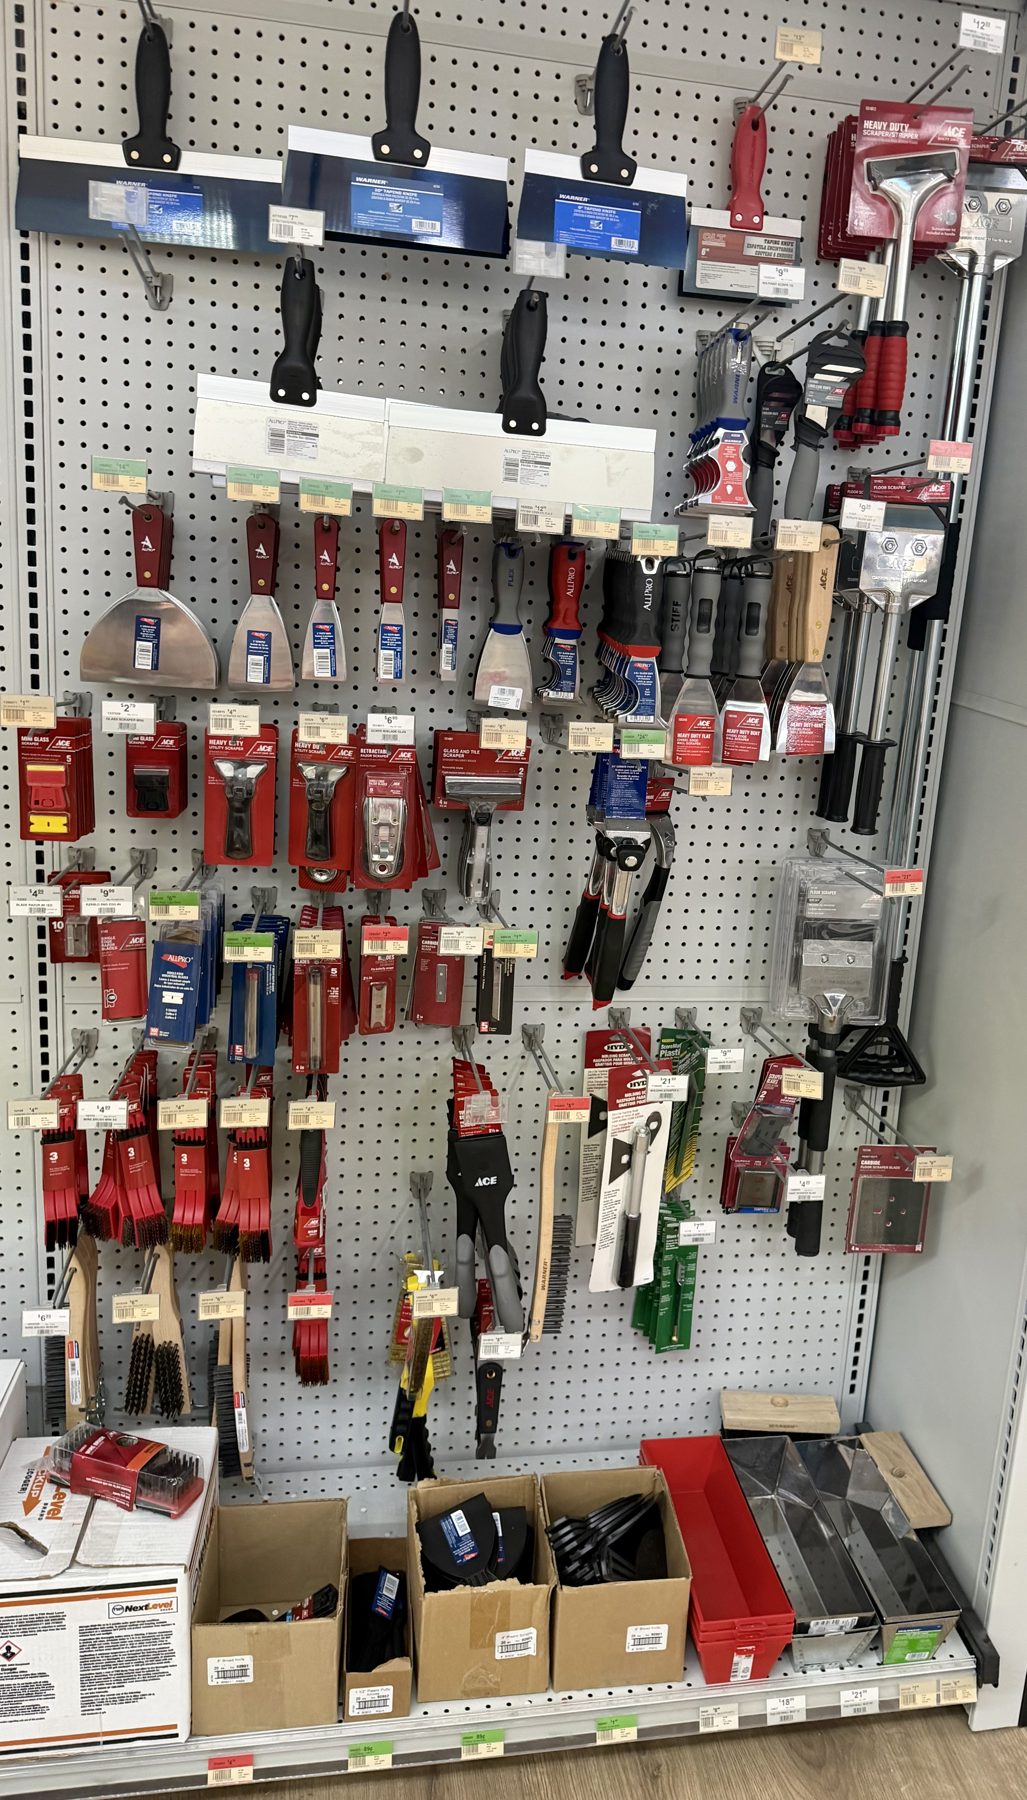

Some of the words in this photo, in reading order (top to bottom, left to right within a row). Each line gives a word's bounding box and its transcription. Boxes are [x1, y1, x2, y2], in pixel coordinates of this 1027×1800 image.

[863, 120, 888, 131] HEAVY
[889, 123, 910, 132] DUTY
[944, 127, 966, 138] ACE
[355, 177, 386, 185] WARNER
[566, 567, 576, 597] ALLPRO
[643, 578, 653, 611] ALLPRO
[670, 600, 681, 633] STIFF
[338, 749, 353, 757] ACE
[66, 755, 72, 763] 5
[52, 921, 64, 930] 10
[168, 954, 191, 964] ALLPRO
[660, 1049, 680, 1058] Plasti
[760, 1090, 767, 1098] 2
[49, 1152, 59, 1161] 3
[127, 1147, 135, 1157] 3
[181, 1153, 188, 1162] 3
[243, 1158, 250, 1167] 3
[474, 1176, 497, 1187] ACE
